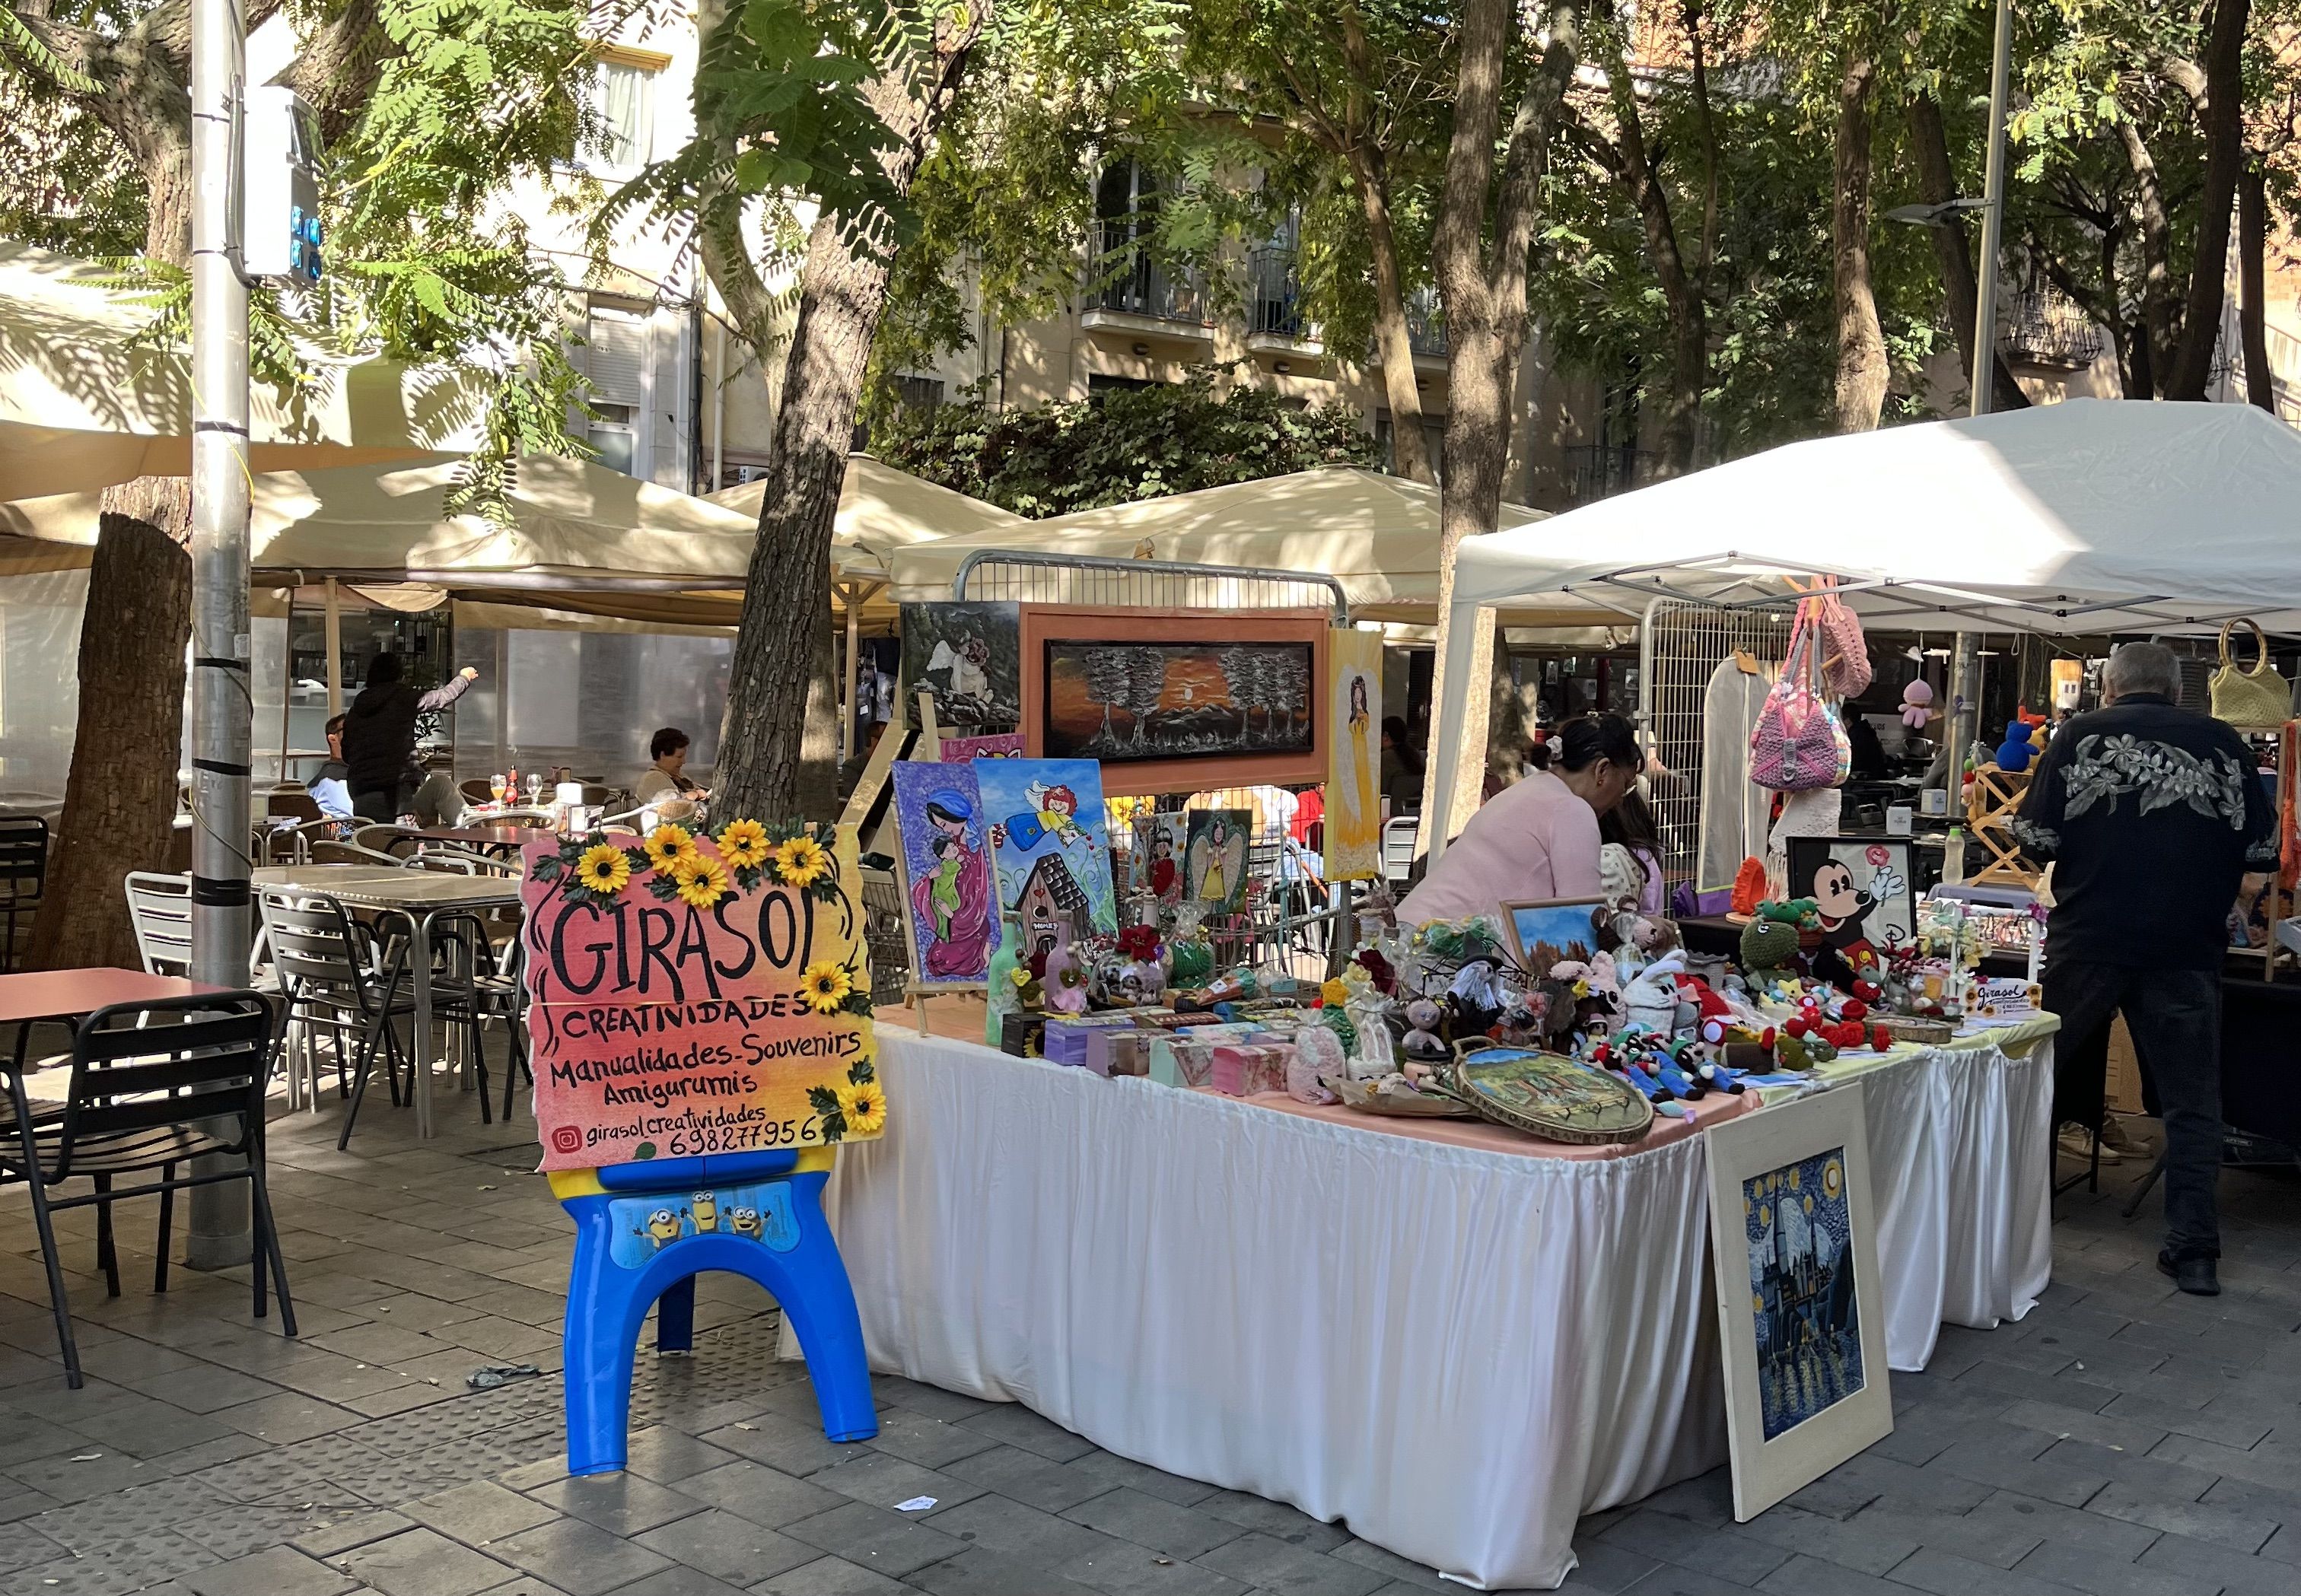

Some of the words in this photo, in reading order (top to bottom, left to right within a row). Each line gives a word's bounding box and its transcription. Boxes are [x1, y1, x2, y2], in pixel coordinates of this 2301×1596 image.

[562, 990, 812, 1042] CREATIVIDADES
[603, 1070, 758, 1108] Amigurumis
[670, 1115, 816, 1155] 698277956
